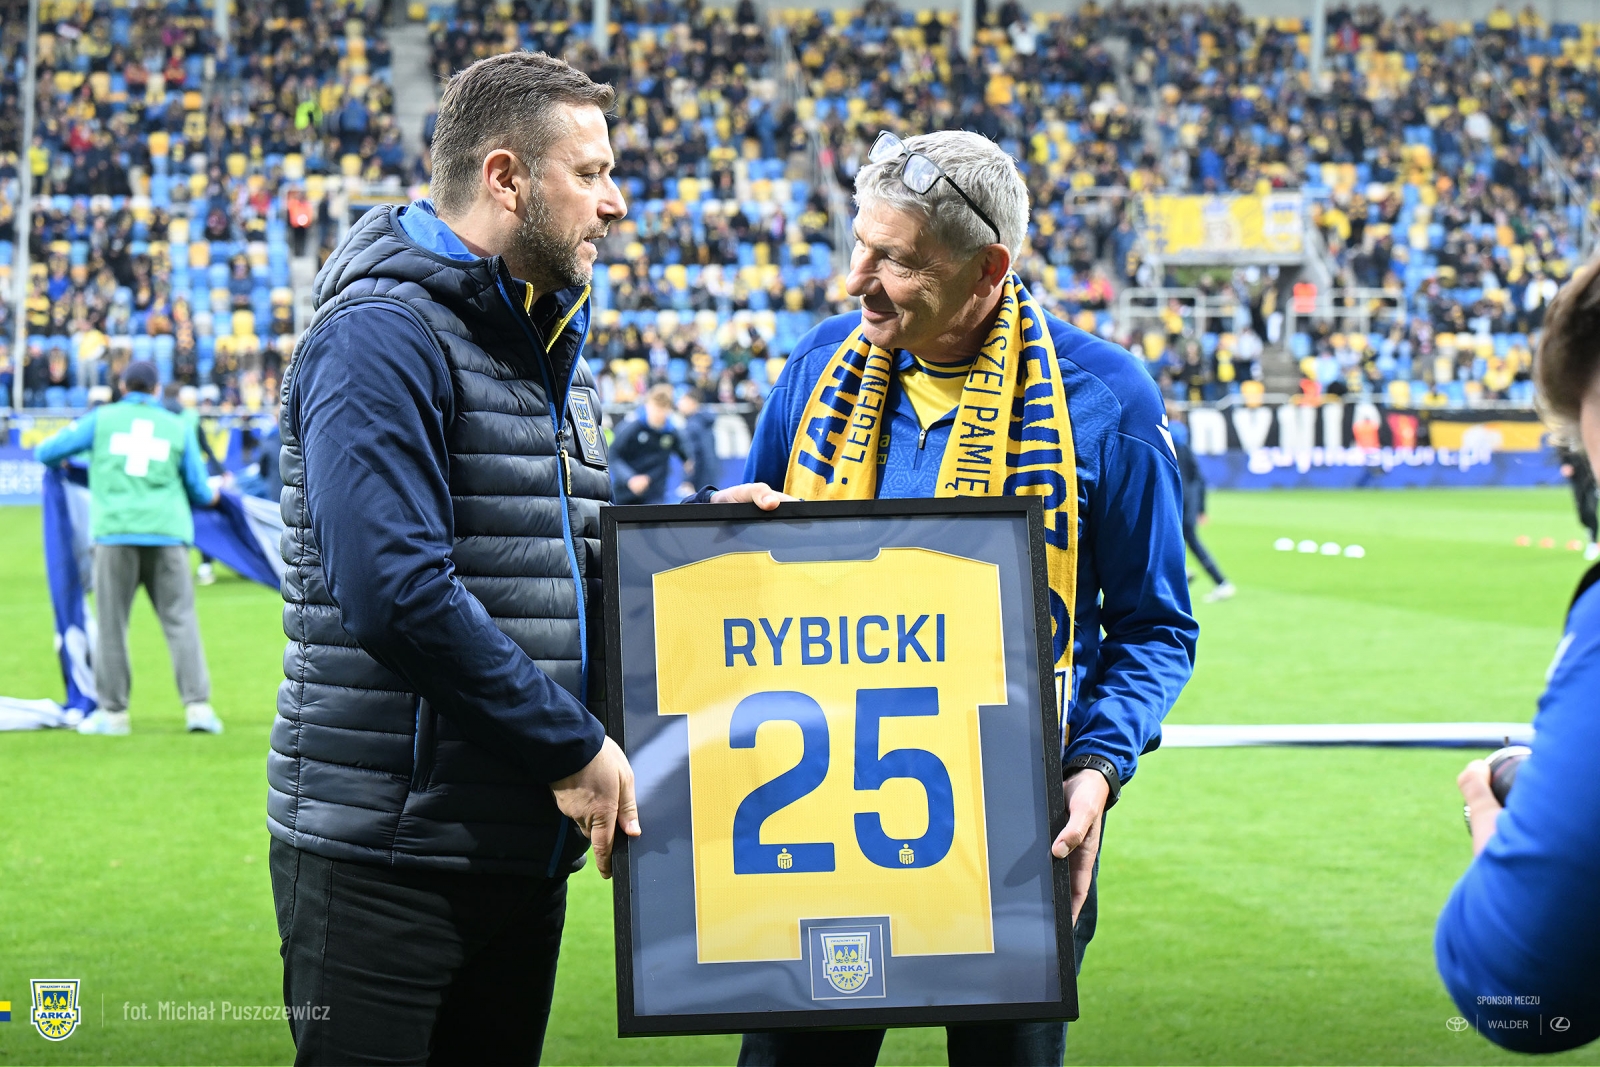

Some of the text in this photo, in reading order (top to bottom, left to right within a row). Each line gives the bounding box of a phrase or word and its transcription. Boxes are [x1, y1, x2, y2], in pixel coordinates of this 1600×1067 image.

[841, 349, 892, 464] LEGEND
[945, 405, 998, 497] PAMIĘ
[723, 613, 946, 667] RYBICKI
[729, 686, 955, 875] 25
[832, 964, 864, 973] ARKA
